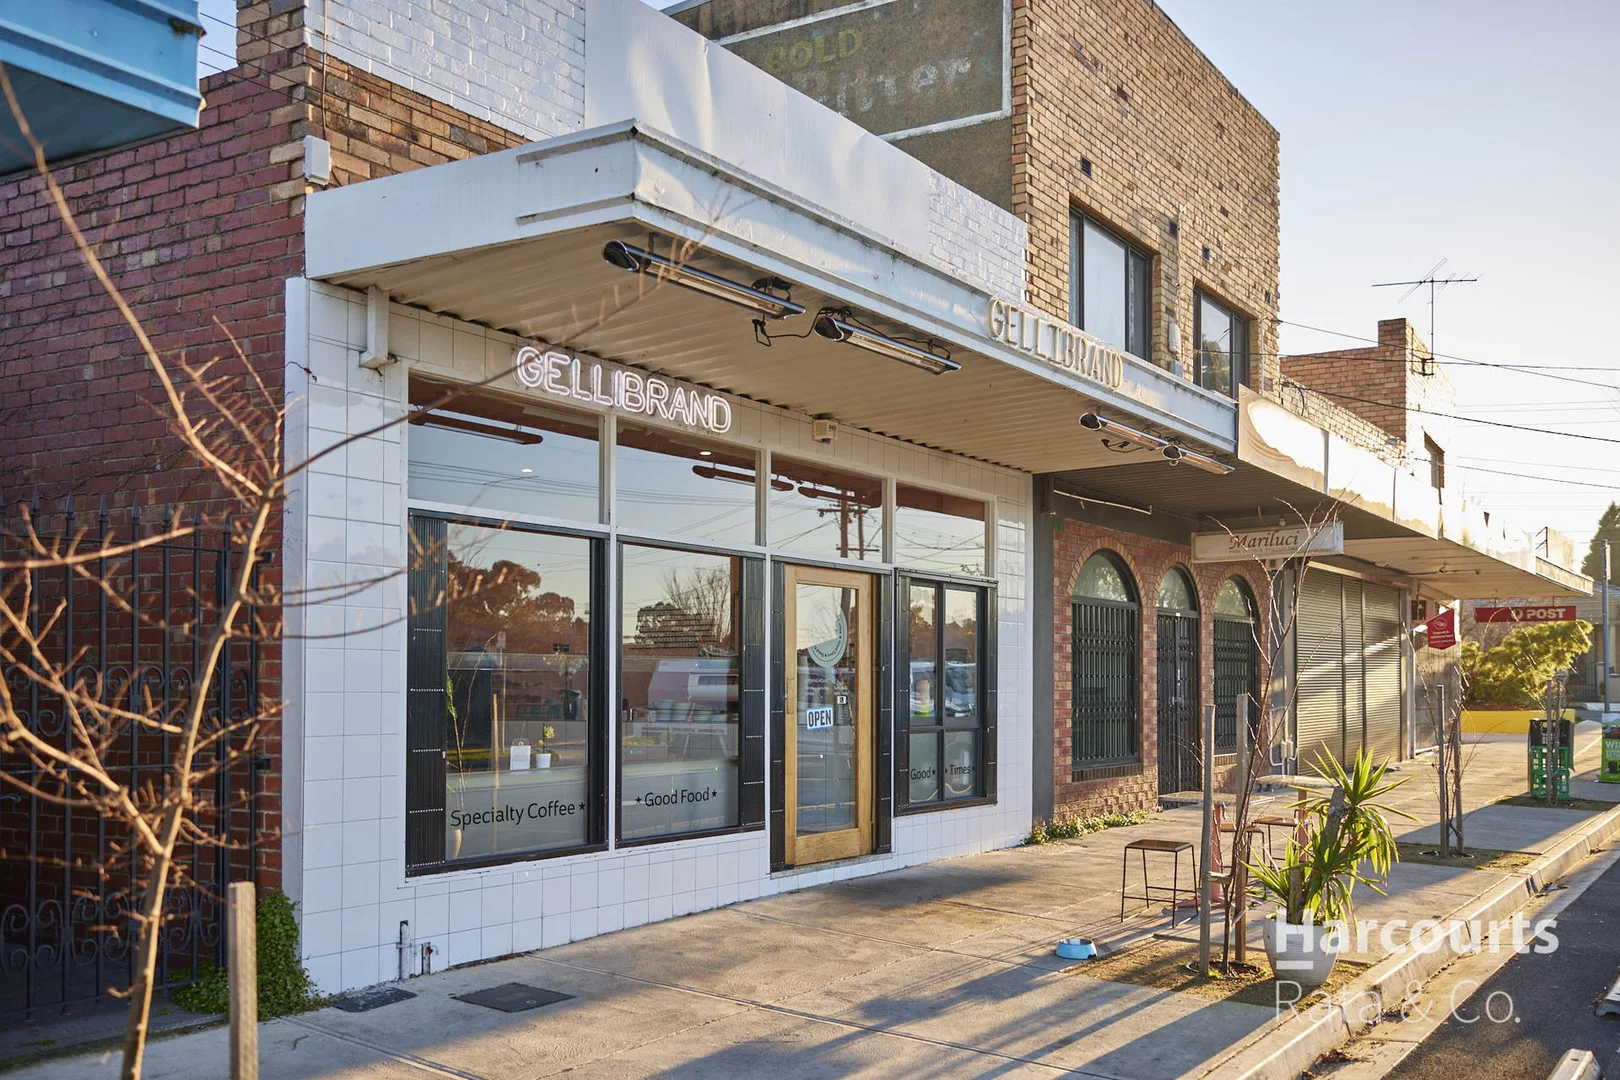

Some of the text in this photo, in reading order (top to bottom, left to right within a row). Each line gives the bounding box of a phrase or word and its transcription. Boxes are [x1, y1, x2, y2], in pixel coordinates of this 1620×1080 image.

[988, 296, 1124, 390] GELLIBRAND
[515, 345, 732, 434] GELLIBRAND
[1229, 530, 1300, 549] Mariluci
[1526, 608, 1566, 619] POST
[808, 709, 832, 728] OPEN
[1605, 741, 1620, 749] WI
[910, 763, 971, 780] Good Times
[644, 787, 710, 807] Good Food
[450, 800, 576, 831] Specialty Coffee
